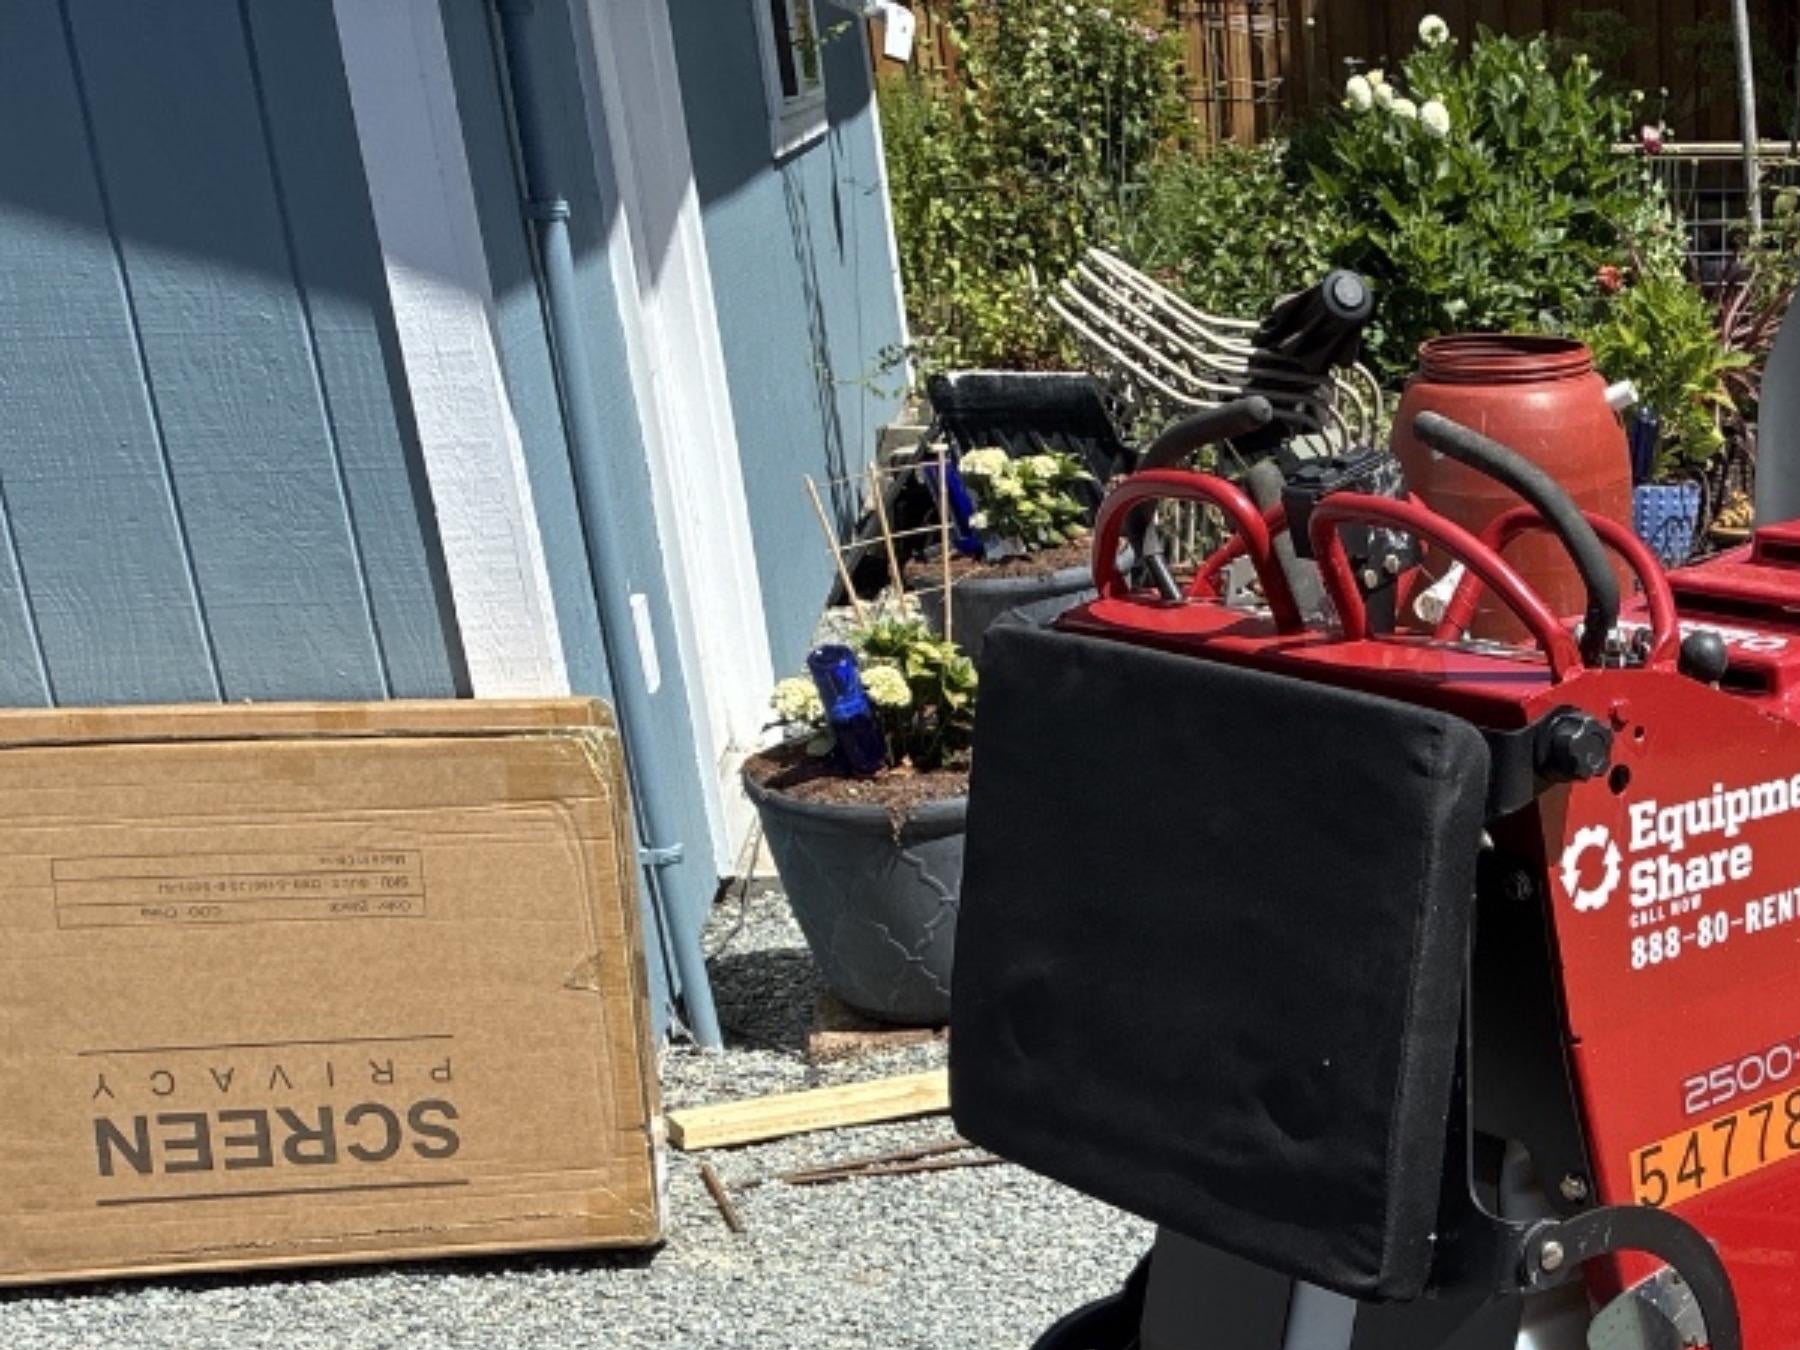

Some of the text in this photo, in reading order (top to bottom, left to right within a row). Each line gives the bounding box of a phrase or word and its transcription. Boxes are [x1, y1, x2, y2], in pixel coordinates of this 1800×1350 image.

[1629, 842, 1753, 908] Share
[1630, 906, 1666, 929] CALL
[92, 1057, 453, 1099] PRIVACY
[93, 1099, 460, 1177] SCREEN
